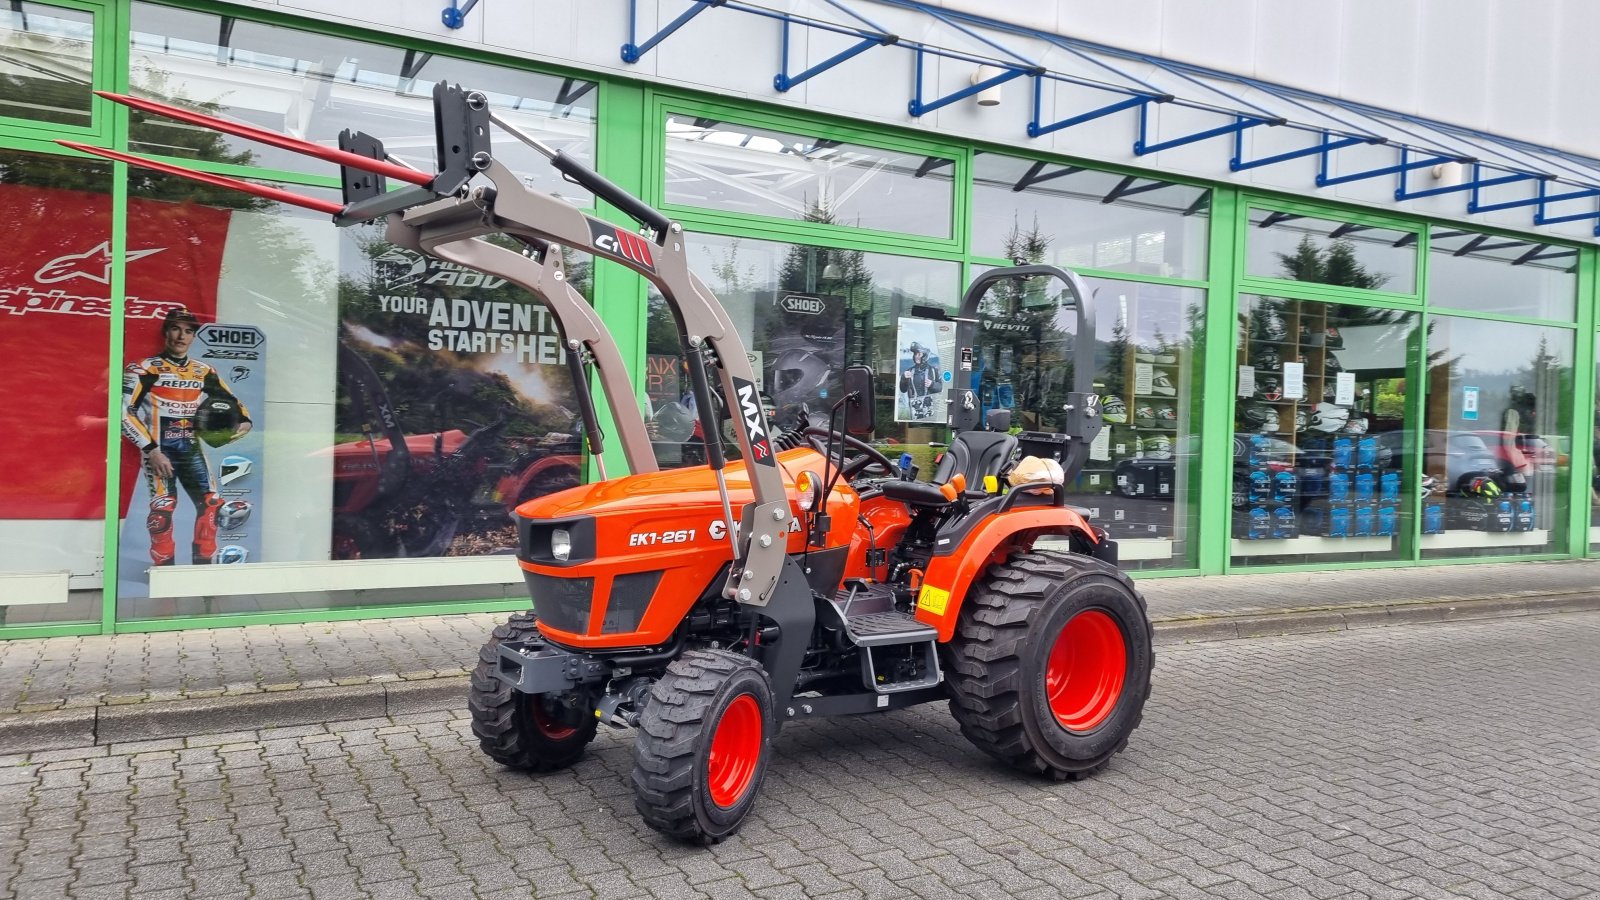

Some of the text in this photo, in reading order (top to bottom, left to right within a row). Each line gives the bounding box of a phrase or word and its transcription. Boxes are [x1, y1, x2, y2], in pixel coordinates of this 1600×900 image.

[595, 234, 619, 253] C1
[378, 295, 428, 314] YOUR
[788, 298, 820, 312] SHOEI
[208, 329, 256, 345] SHOEI
[428, 330, 515, 354] STARTS
[737, 384, 767, 441] MX
[629, 529, 696, 546] EK1-261
